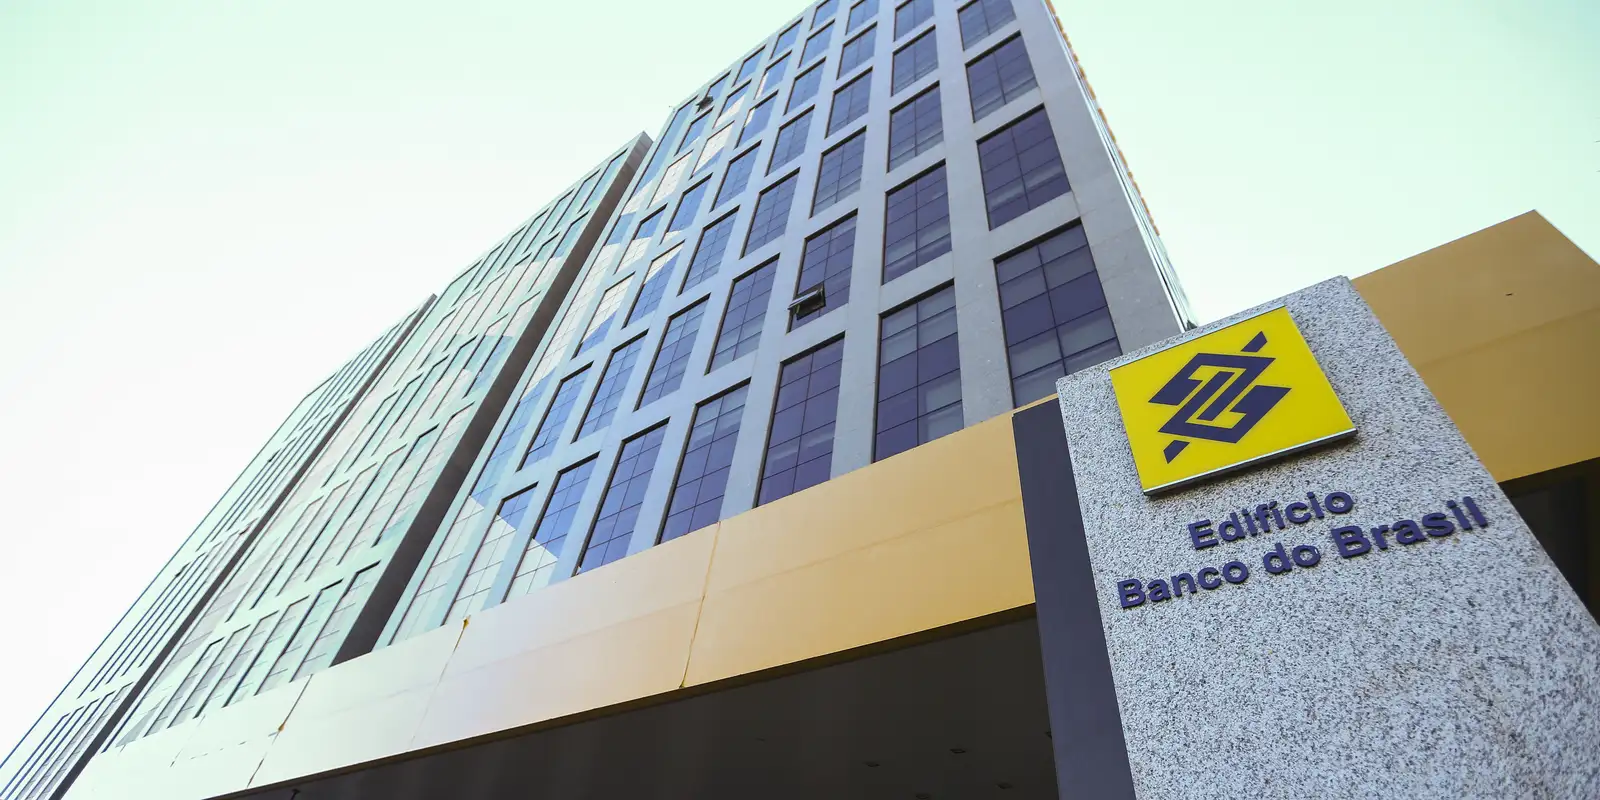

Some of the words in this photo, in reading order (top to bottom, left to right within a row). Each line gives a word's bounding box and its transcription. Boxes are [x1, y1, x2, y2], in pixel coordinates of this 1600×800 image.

[1117, 560, 1249, 609] Banco
[1262, 542, 1322, 575] do
[1331, 496, 1489, 559] Brasil
[1188, 491, 1354, 550] Edifício
